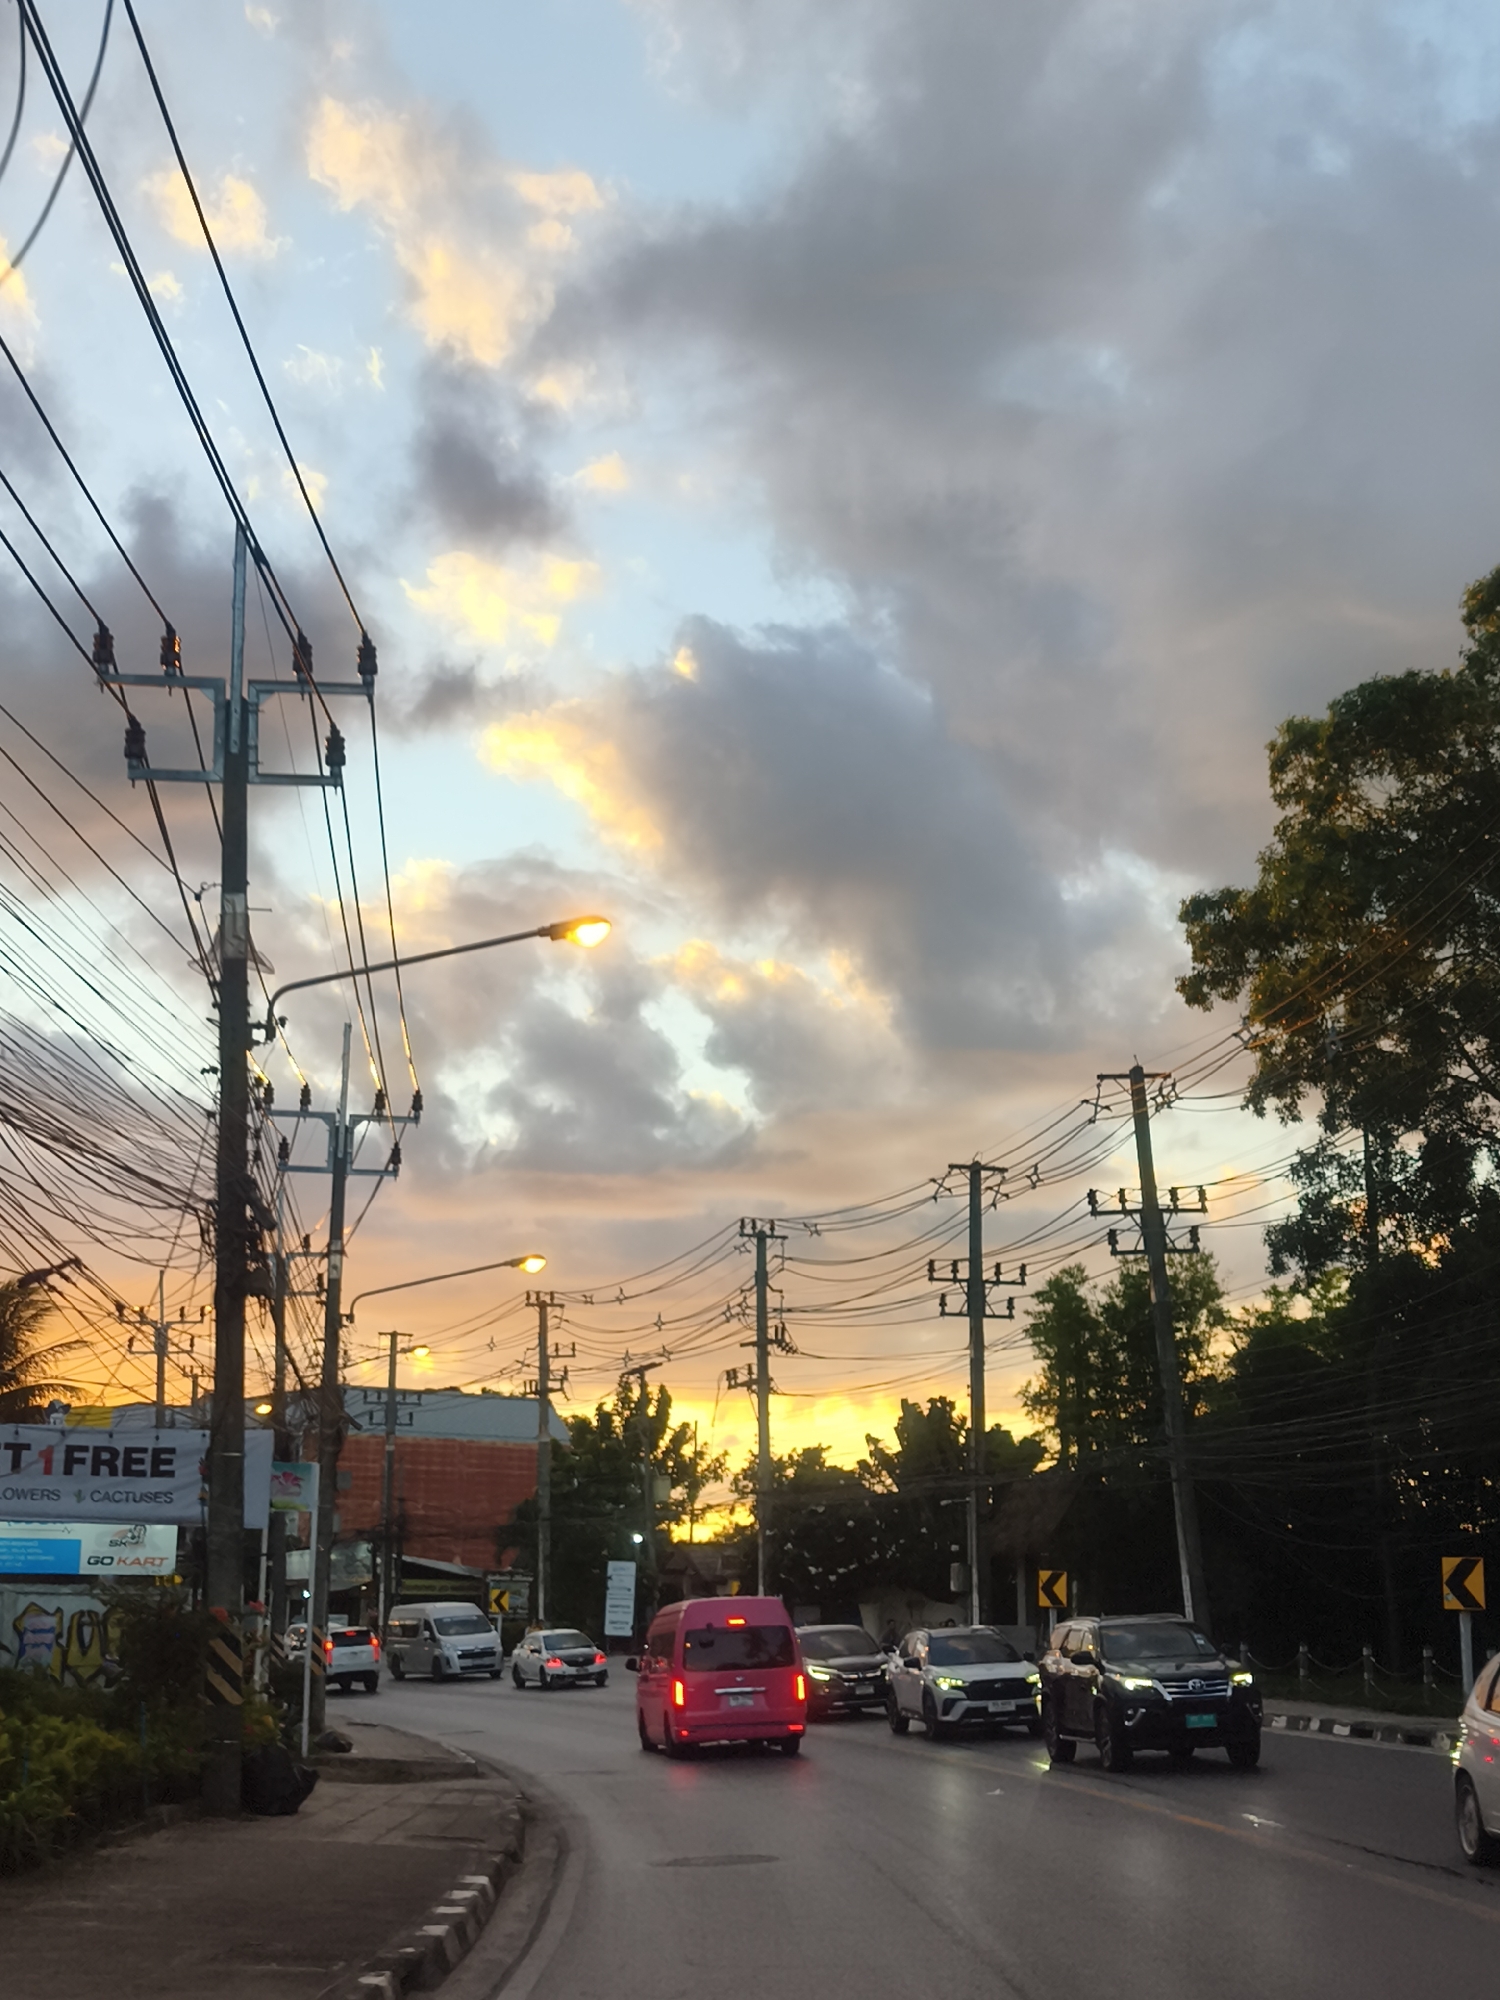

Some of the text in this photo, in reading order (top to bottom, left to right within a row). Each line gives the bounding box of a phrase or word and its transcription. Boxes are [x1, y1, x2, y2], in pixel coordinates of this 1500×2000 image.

[0, 1442, 176, 1478] T 1 FREE
[90, 1490, 174, 1504] CACTUSES
[87, 1556, 169, 1567] GO KART
